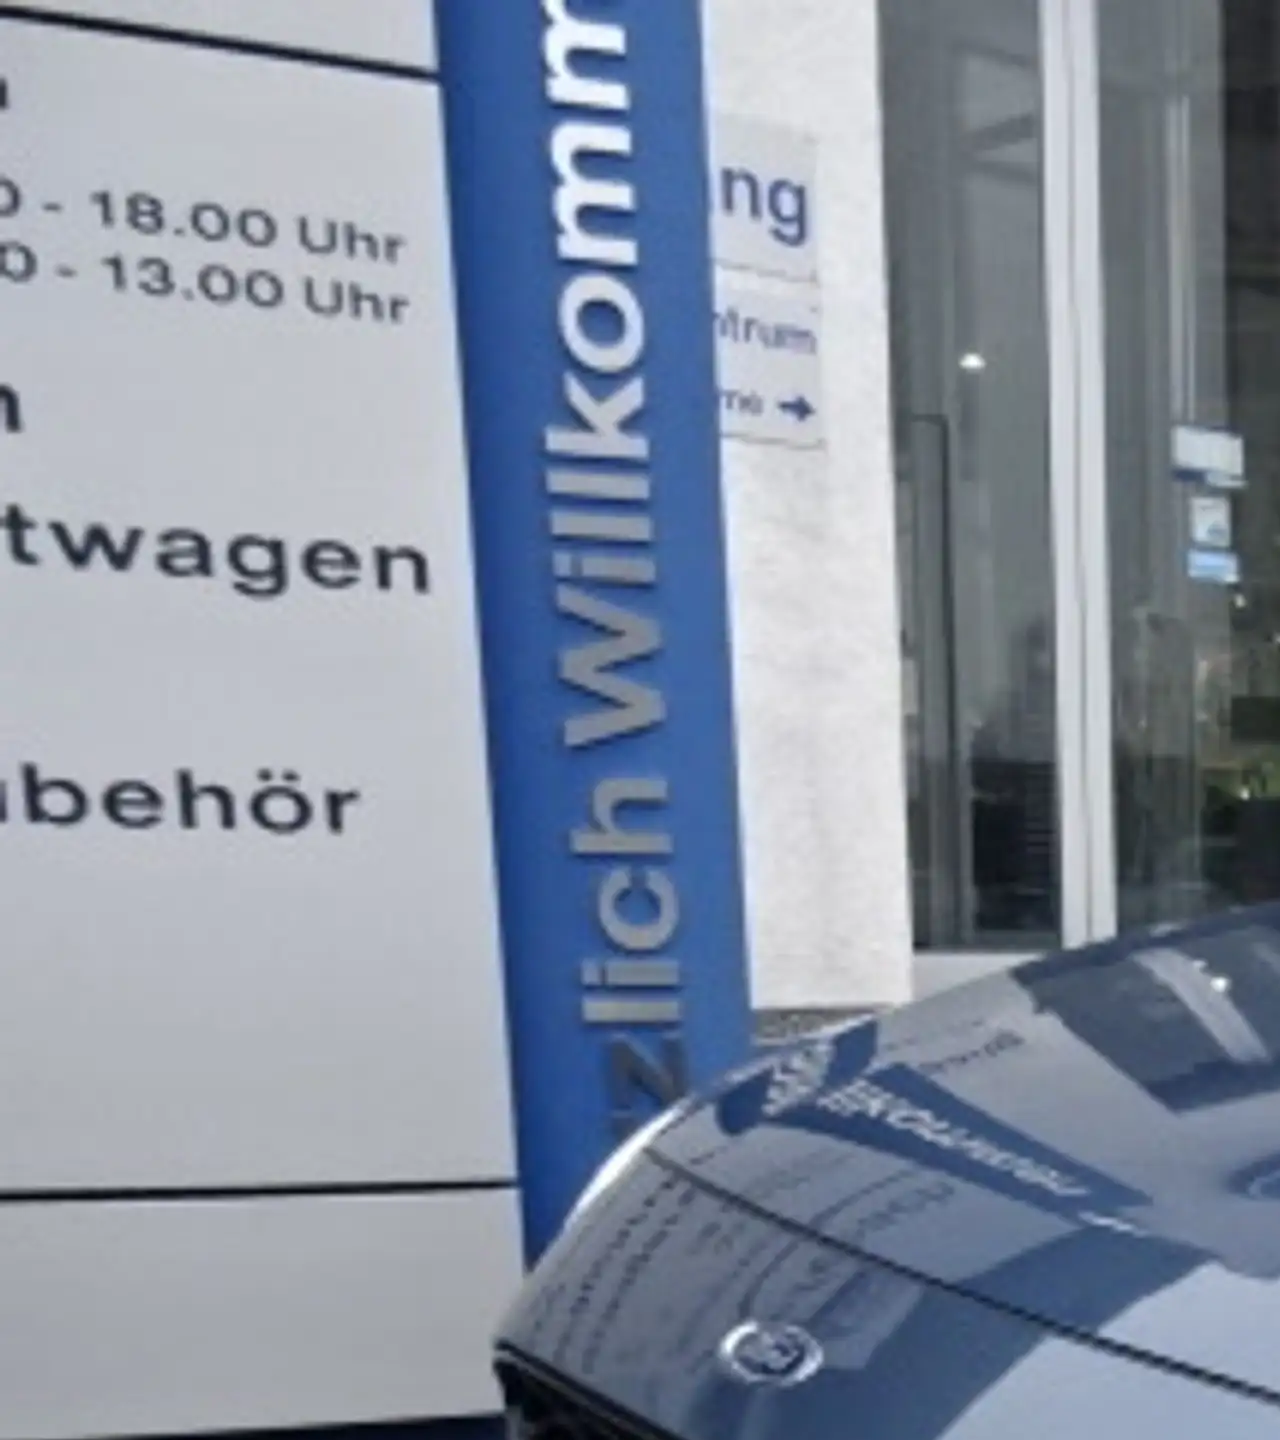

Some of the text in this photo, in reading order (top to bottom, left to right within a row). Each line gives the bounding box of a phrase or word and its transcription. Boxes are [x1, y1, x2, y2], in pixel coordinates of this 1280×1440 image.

[90, 190, 278, 250] 18.00
[296, 215, 407, 265] Uhr
[102, 254, 286, 310] 13.00
[304, 276, 411, 325] Uhr
[0, 503, 432, 600] twagen
[0, 762, 362, 836] behör
